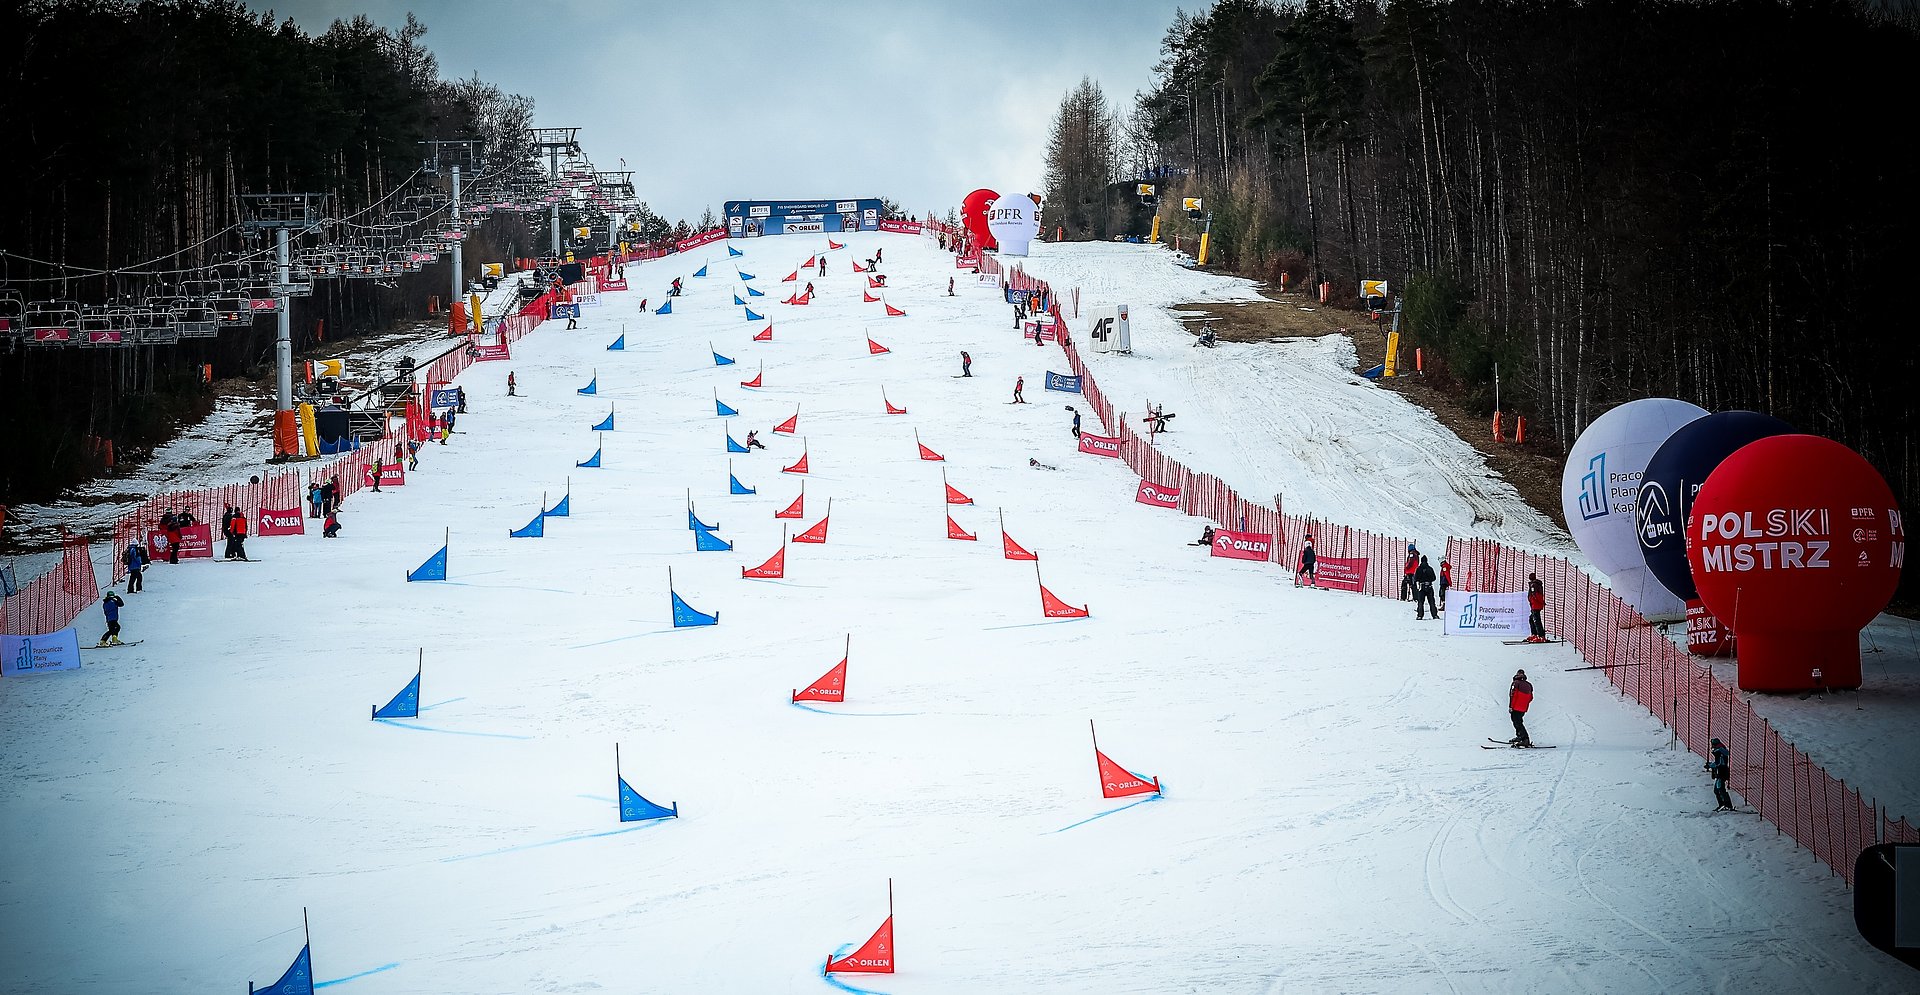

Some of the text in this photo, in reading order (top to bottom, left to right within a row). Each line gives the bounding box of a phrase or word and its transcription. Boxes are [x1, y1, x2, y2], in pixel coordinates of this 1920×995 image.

[997, 208, 1023, 220] PFR
[583, 295, 597, 303] PFR
[1091, 317, 1115, 343] 4F
[1093, 442, 1118, 451] ORLEN
[1610, 471, 1645, 483] Praco
[1859, 507, 1875, 517] PFR
[274, 516, 300, 527] ORLEN
[1701, 508, 1830, 540] POLSKI
[1656, 521, 1676, 536] PKL
[1233, 540, 1268, 552] ORLEN
[1702, 541, 1830, 573] MISTRZ
[1319, 562, 1351, 571] Ministerstwo
[1338, 571, 1360, 579] Turystyki
[1479, 606, 1515, 614] Pracownicze
[33, 646, 64, 654] Pracownicze
[1118, 780, 1144, 789] ORLEN
[860, 959, 890, 967] ORLEN
